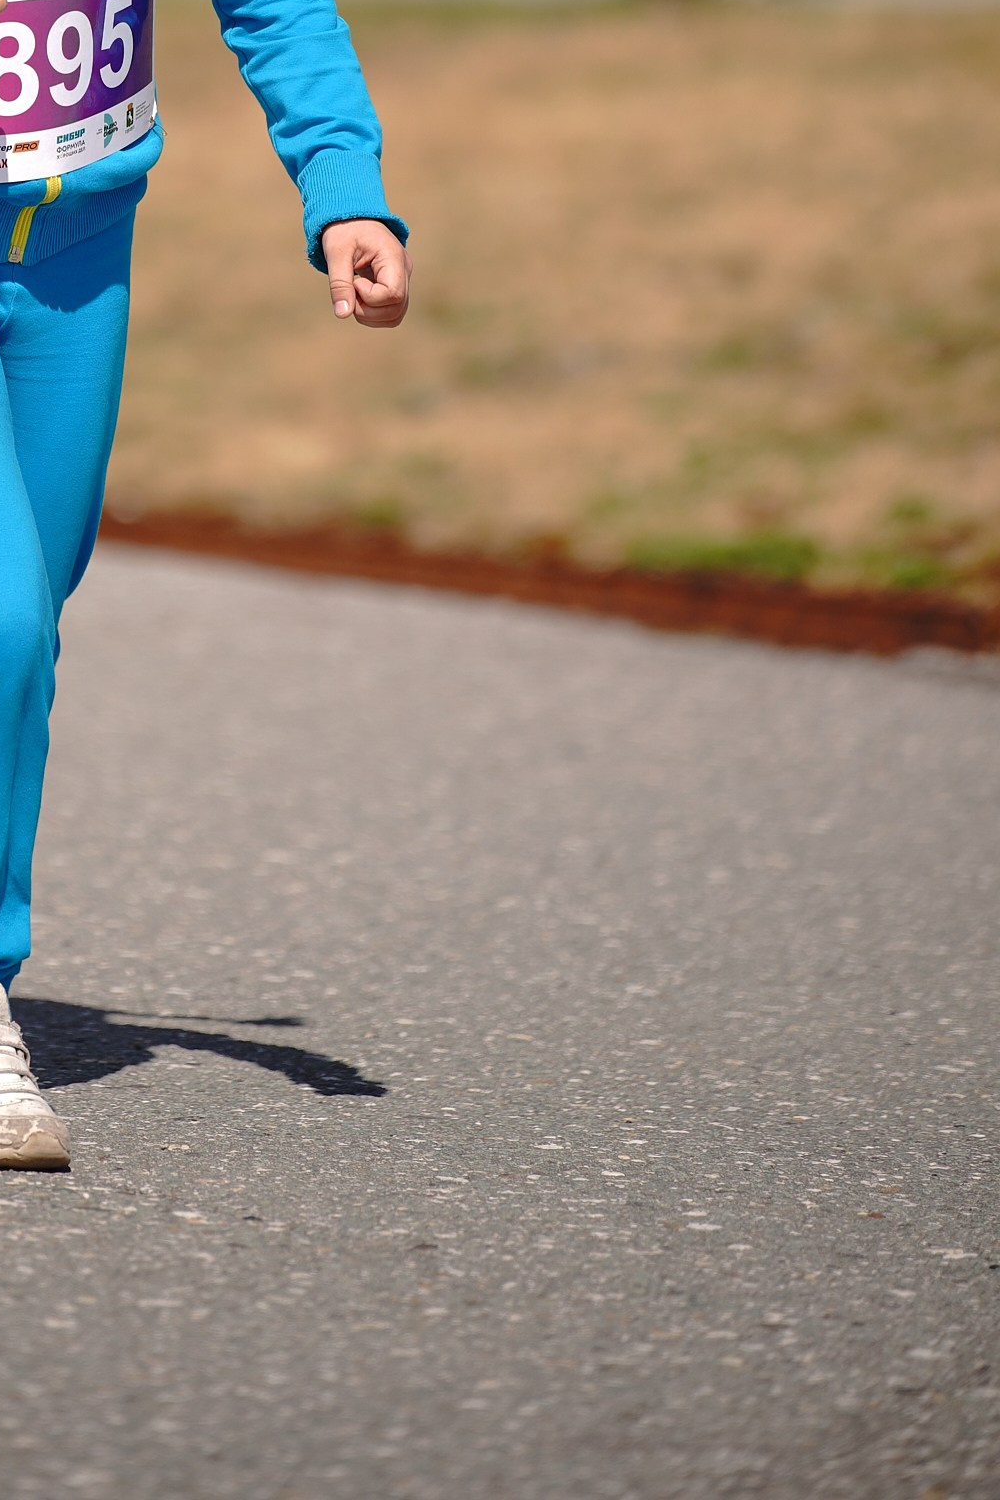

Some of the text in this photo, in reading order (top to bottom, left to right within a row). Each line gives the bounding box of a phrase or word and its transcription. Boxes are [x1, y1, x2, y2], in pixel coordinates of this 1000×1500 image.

[57, 128, 86, 144] СИБУР
[14, 142, 38, 152] PRO
[57, 140, 86, 153] ФОРМУЛА
